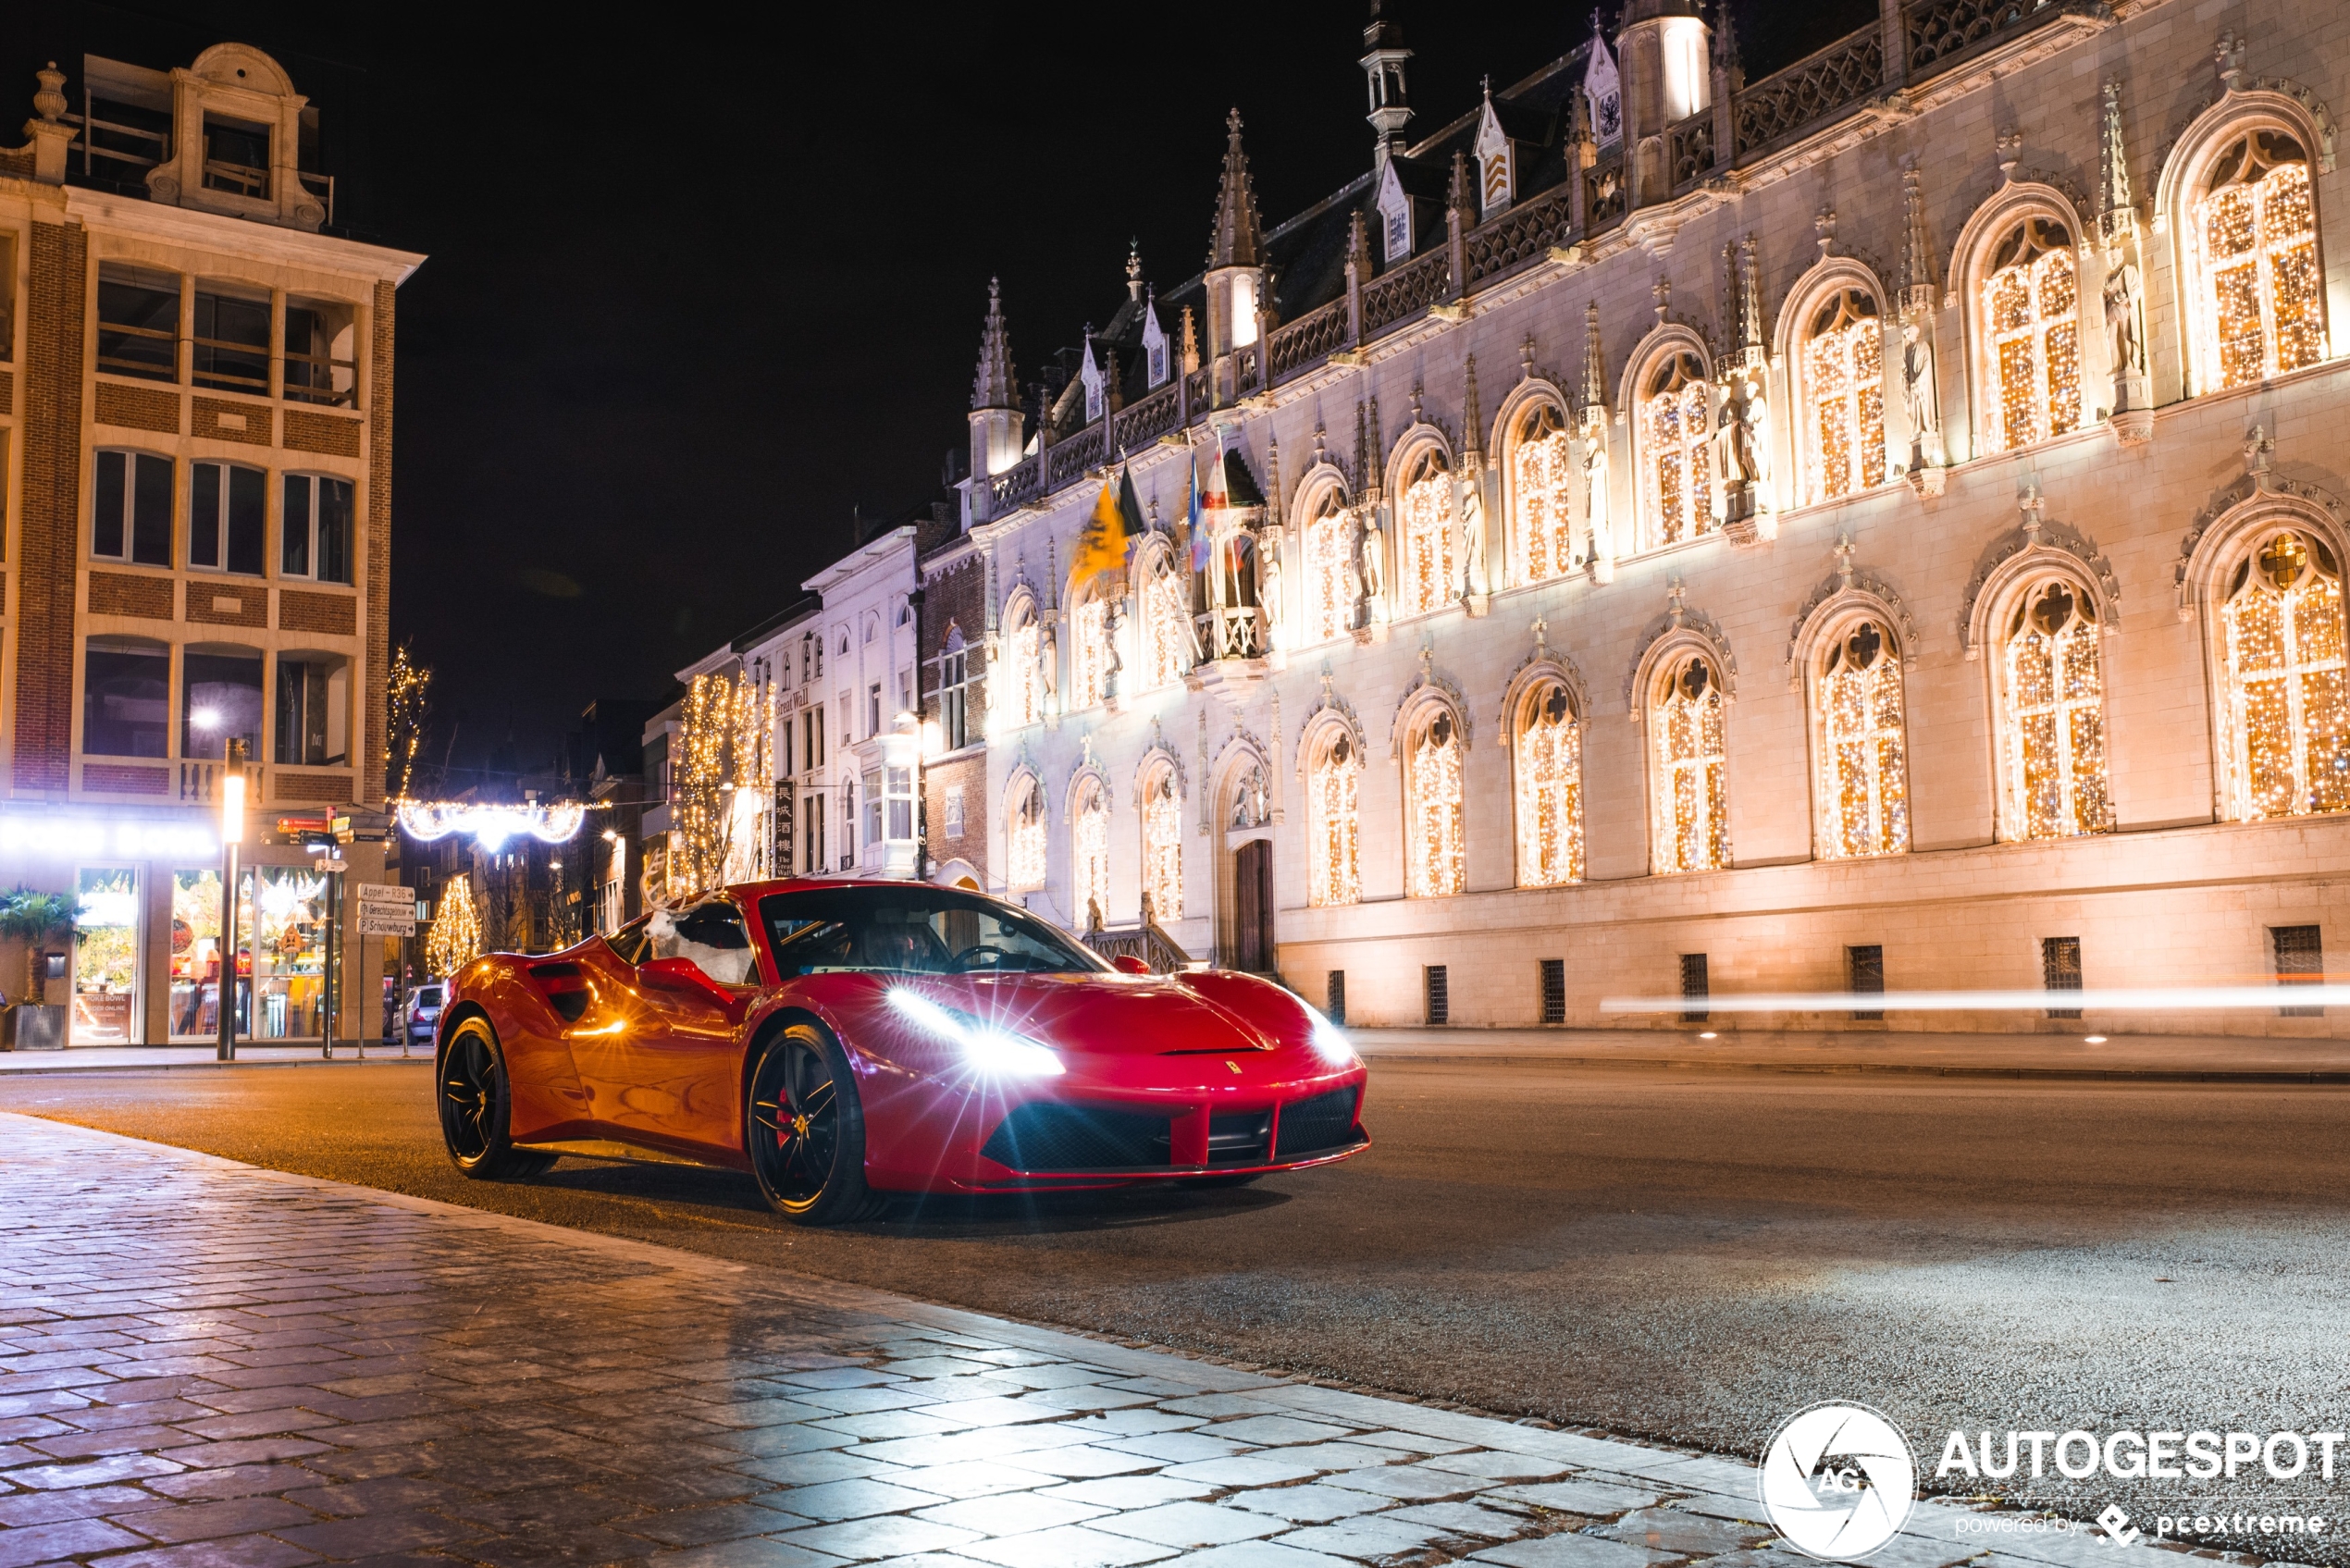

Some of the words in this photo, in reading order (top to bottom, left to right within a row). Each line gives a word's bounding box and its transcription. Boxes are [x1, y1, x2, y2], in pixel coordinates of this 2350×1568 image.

[775, 696, 793, 717] Great
[793, 687, 809, 710] Wall
[363, 886, 384, 899] Appel
[391, 888, 406, 898] R36
[369, 904, 407, 918] Gerechtsgebouw
[369, 920, 407, 935] Schouwburg
